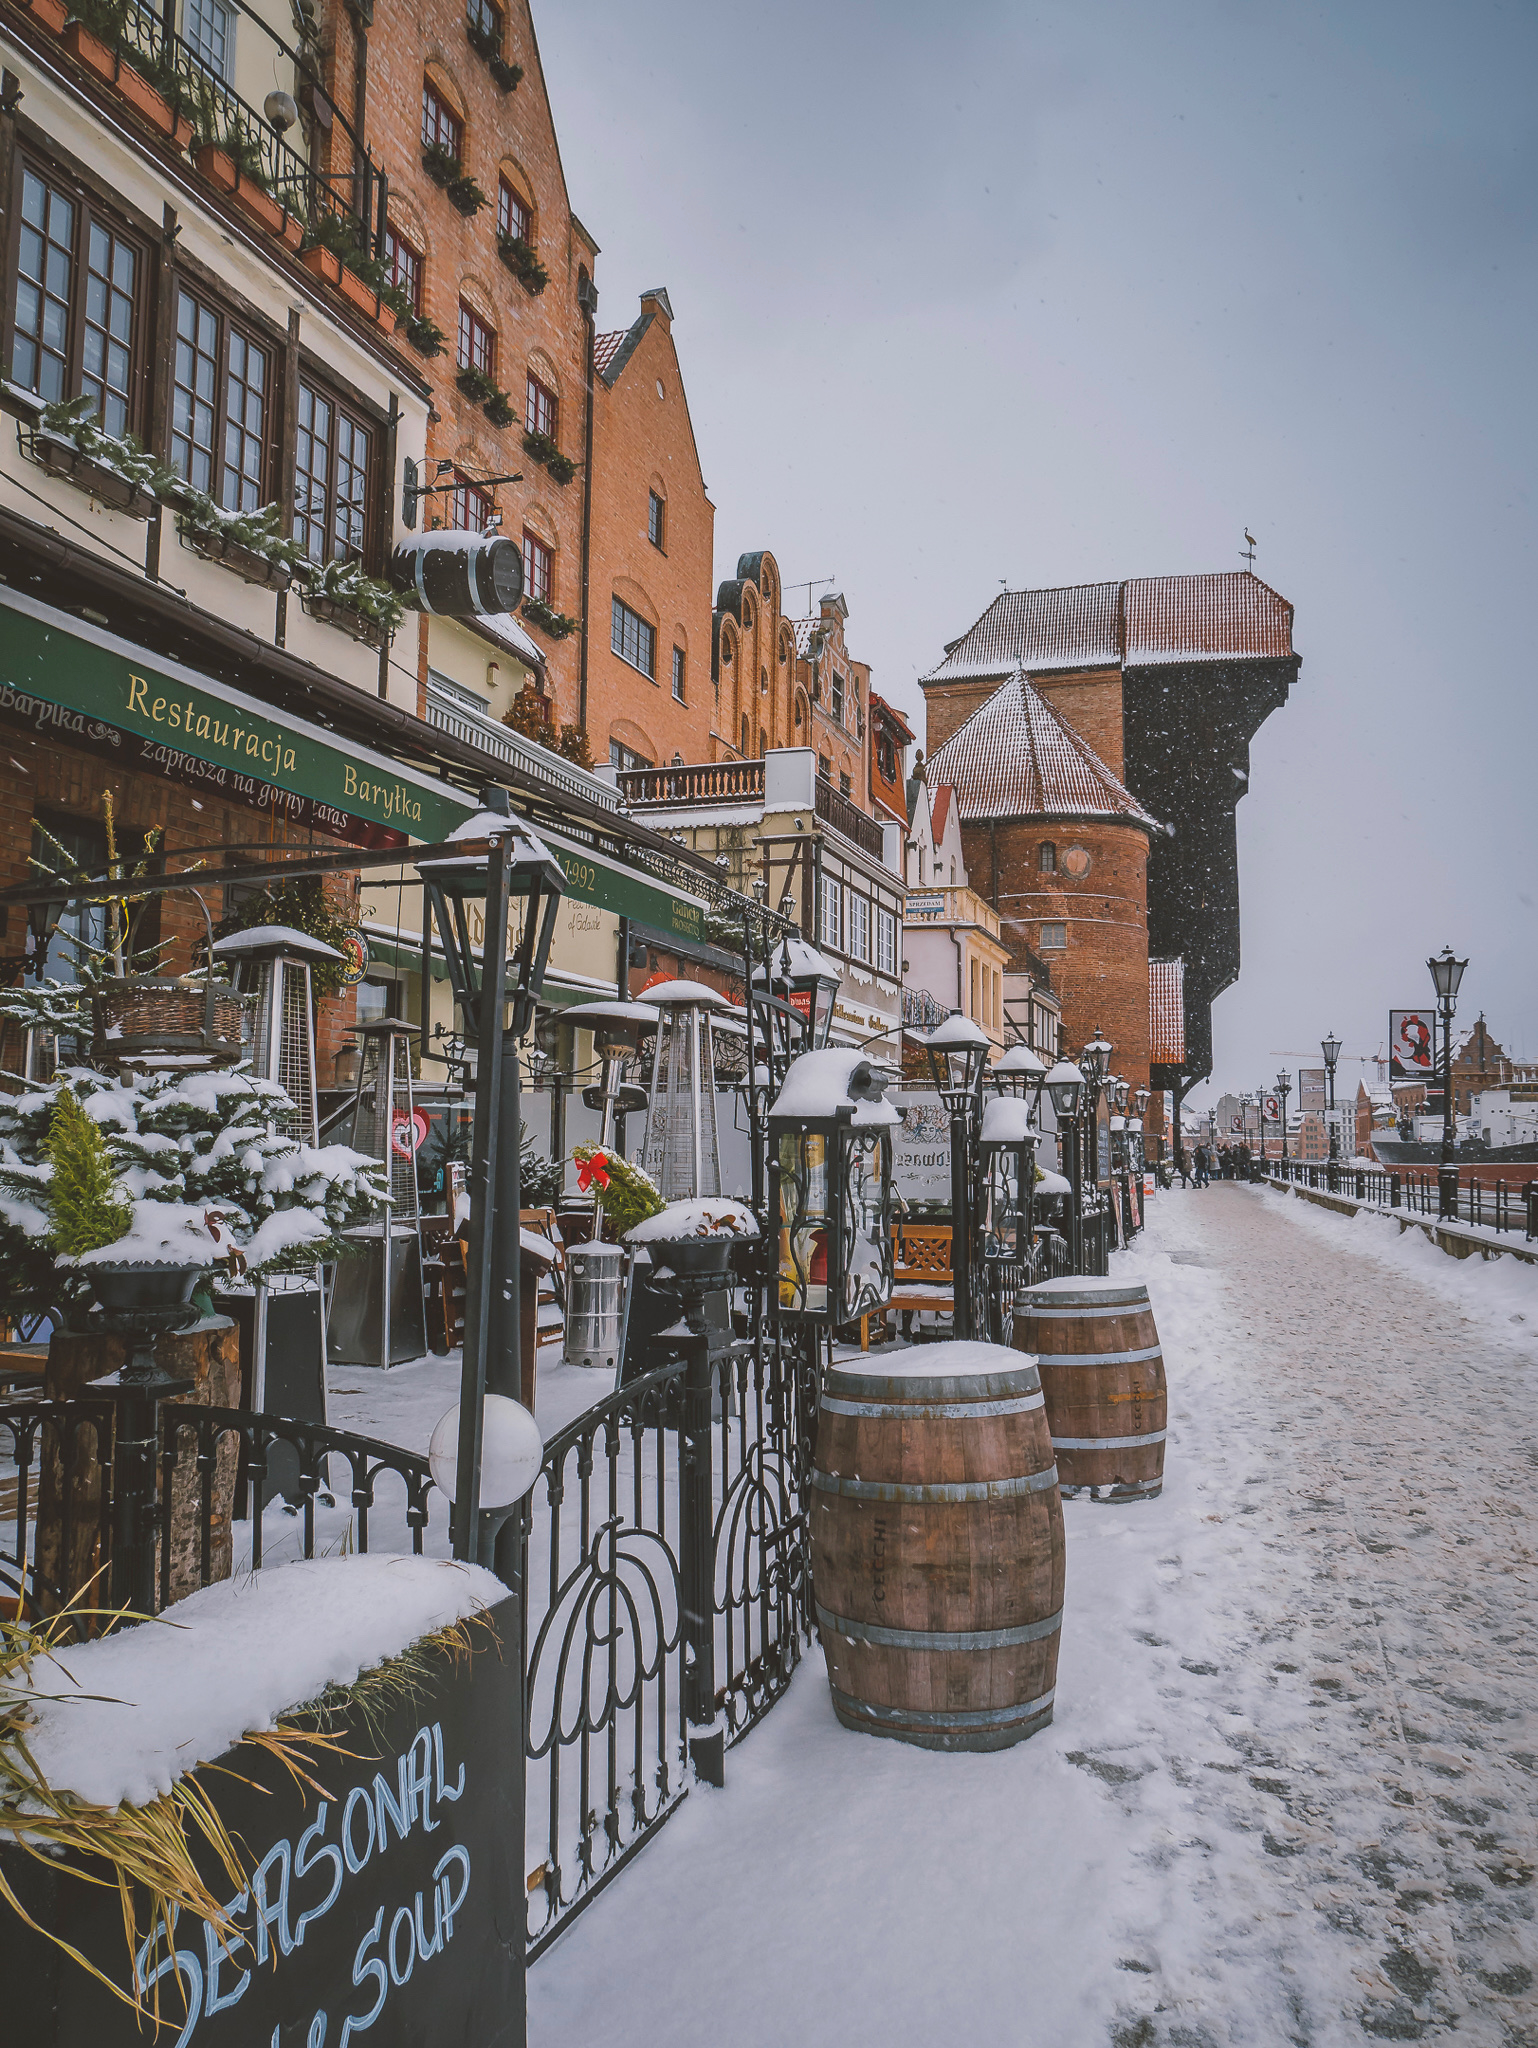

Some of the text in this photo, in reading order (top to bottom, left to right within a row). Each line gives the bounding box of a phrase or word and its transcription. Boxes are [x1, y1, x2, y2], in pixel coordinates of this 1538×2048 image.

[126, 673, 422, 822] Restauracja Baryłka
[140, 740, 227, 785] zaprasza
[233, 774, 255, 794] na
[312, 800, 348, 828] taras
[564, 859, 595, 891] 1992
[671, 900, 700, 924] Gancia
[1132, 1381, 1142, 1430] CECCHI
[872, 1519, 887, 1602] CECCHI
[132, 1721, 466, 2048] SEASONAL
[338, 1844, 471, 2048] SOUP
